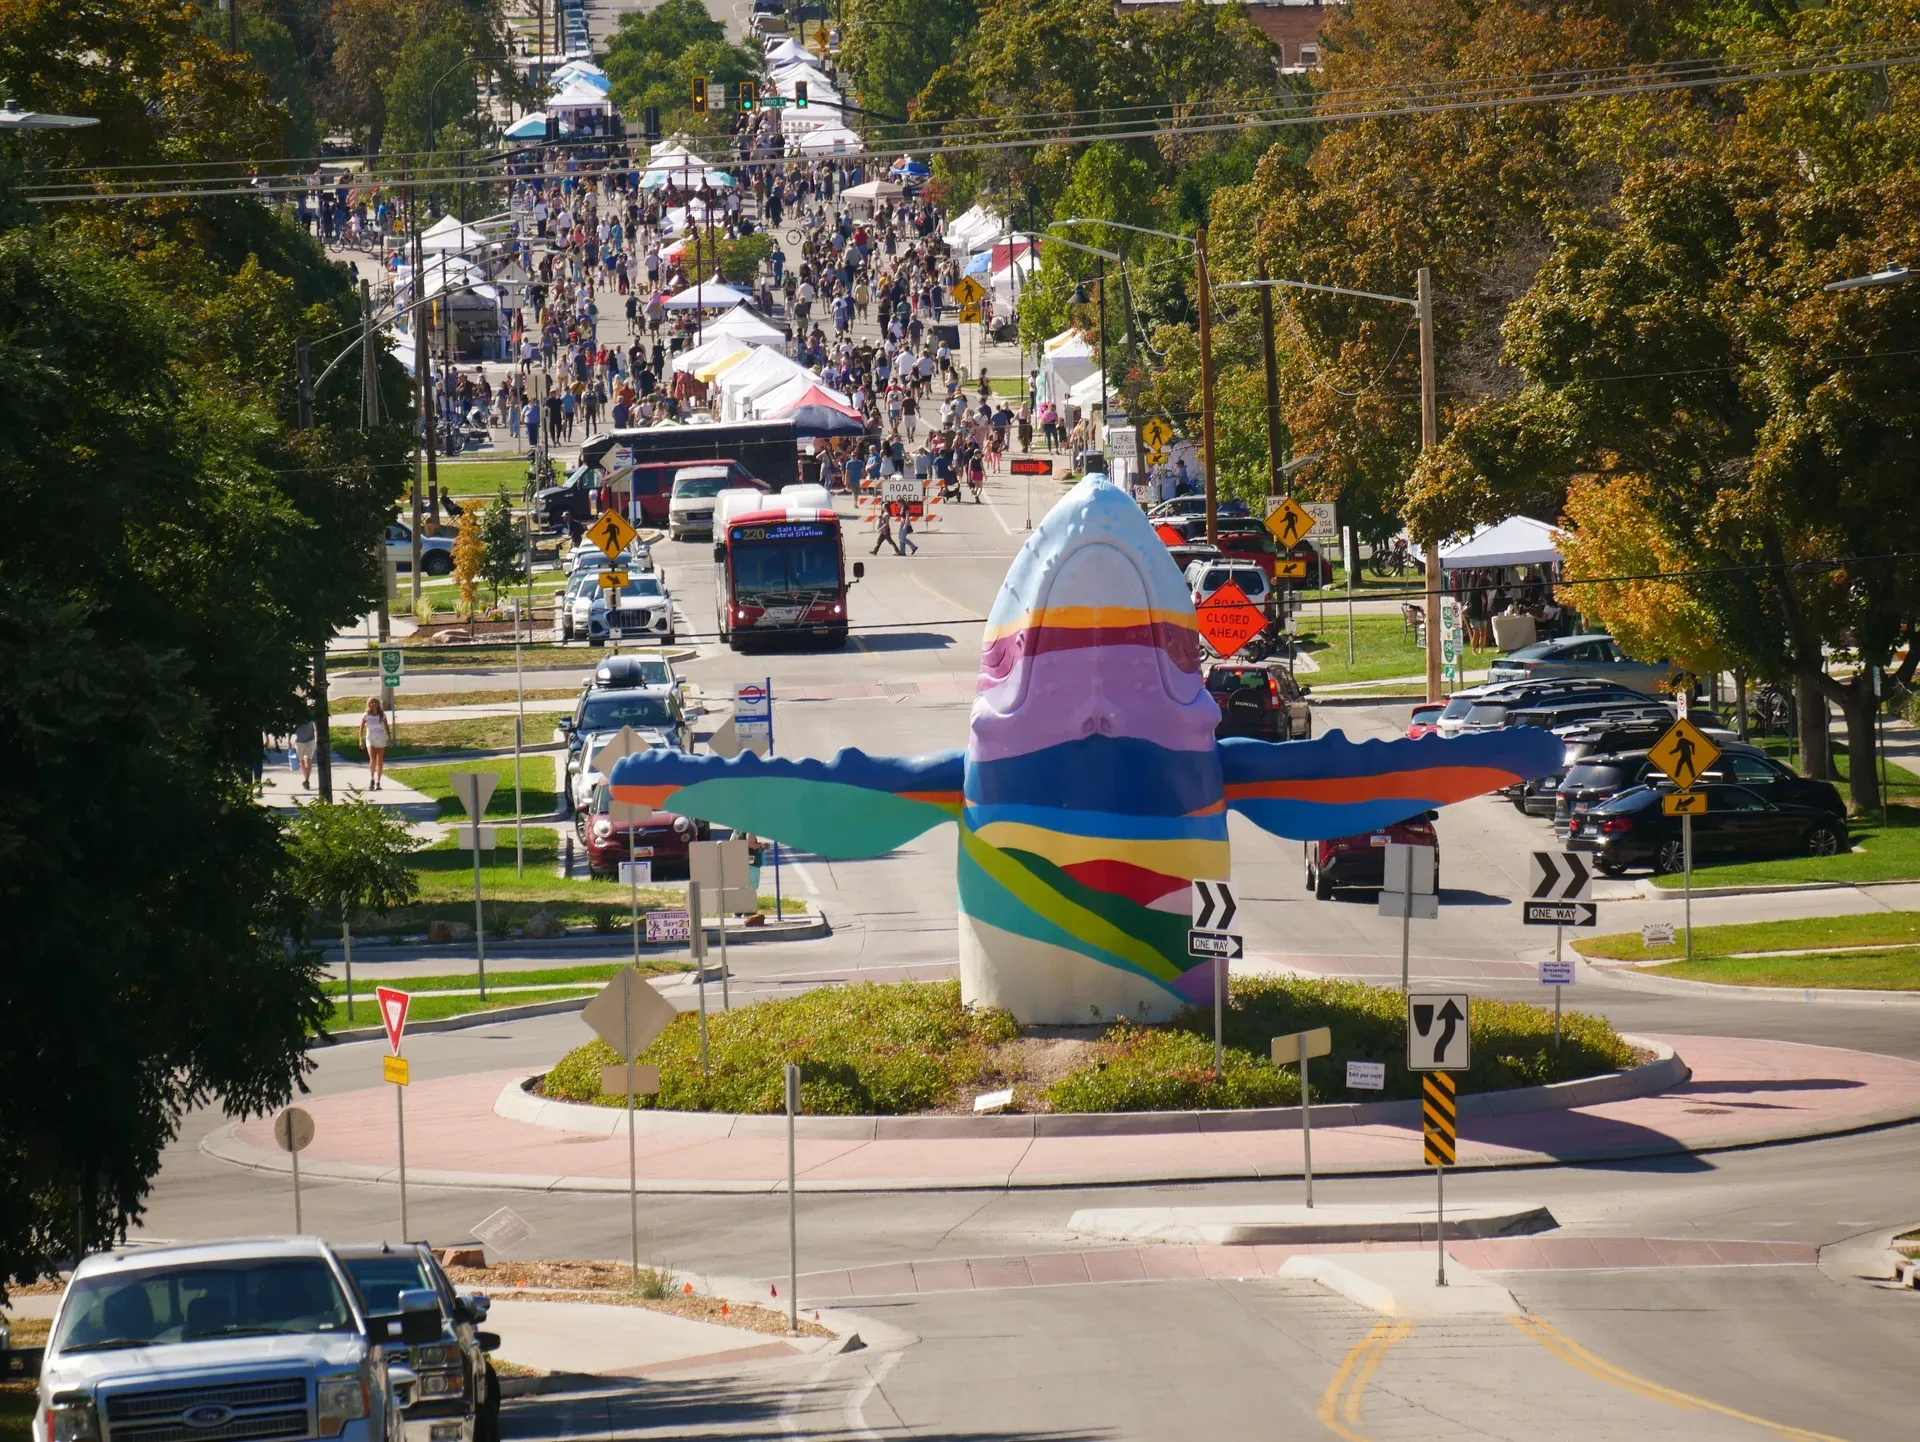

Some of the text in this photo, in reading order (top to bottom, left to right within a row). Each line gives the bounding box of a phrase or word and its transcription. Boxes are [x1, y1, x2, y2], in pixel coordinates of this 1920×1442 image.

[889, 484, 914, 492] ROAD
[885, 494, 919, 502] CLOSED
[743, 529, 764, 540] 220
[795, 530, 823, 538] Station
[1214, 599, 1244, 610] ROAD
[1206, 613, 1249, 625] CLOSED
[1209, 628, 1247, 639] AHEAD
[1532, 908, 1577, 919] ONE WAY
[678, 919, 690, 928] 21
[666, 928, 688, 936] 10-6
[1195, 939, 1229, 952] ONE WAY
